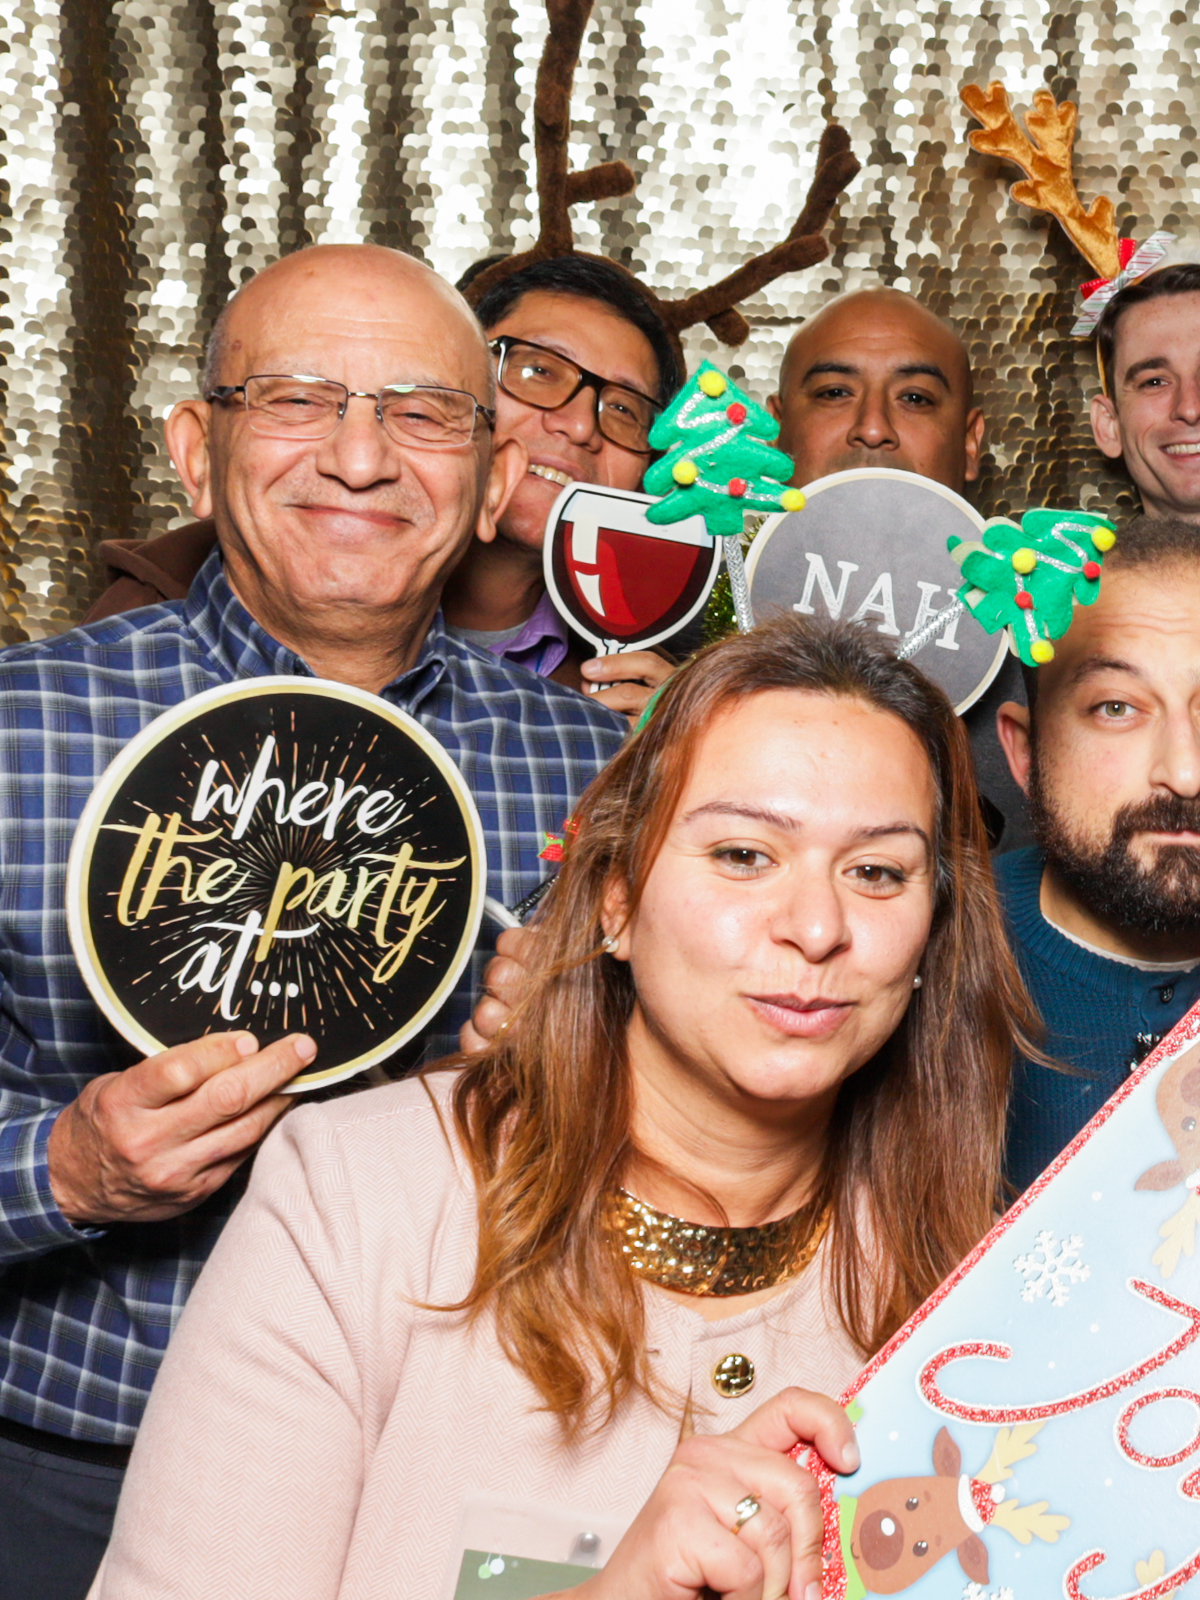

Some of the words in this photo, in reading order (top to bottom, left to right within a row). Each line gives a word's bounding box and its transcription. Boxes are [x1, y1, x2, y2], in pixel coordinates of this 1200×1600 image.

[793, 552, 961, 650] NAH
[191, 735, 405, 841] where
[100, 812, 251, 926] the
[255, 842, 467, 983] party
[178, 910, 320, 1020] at...
